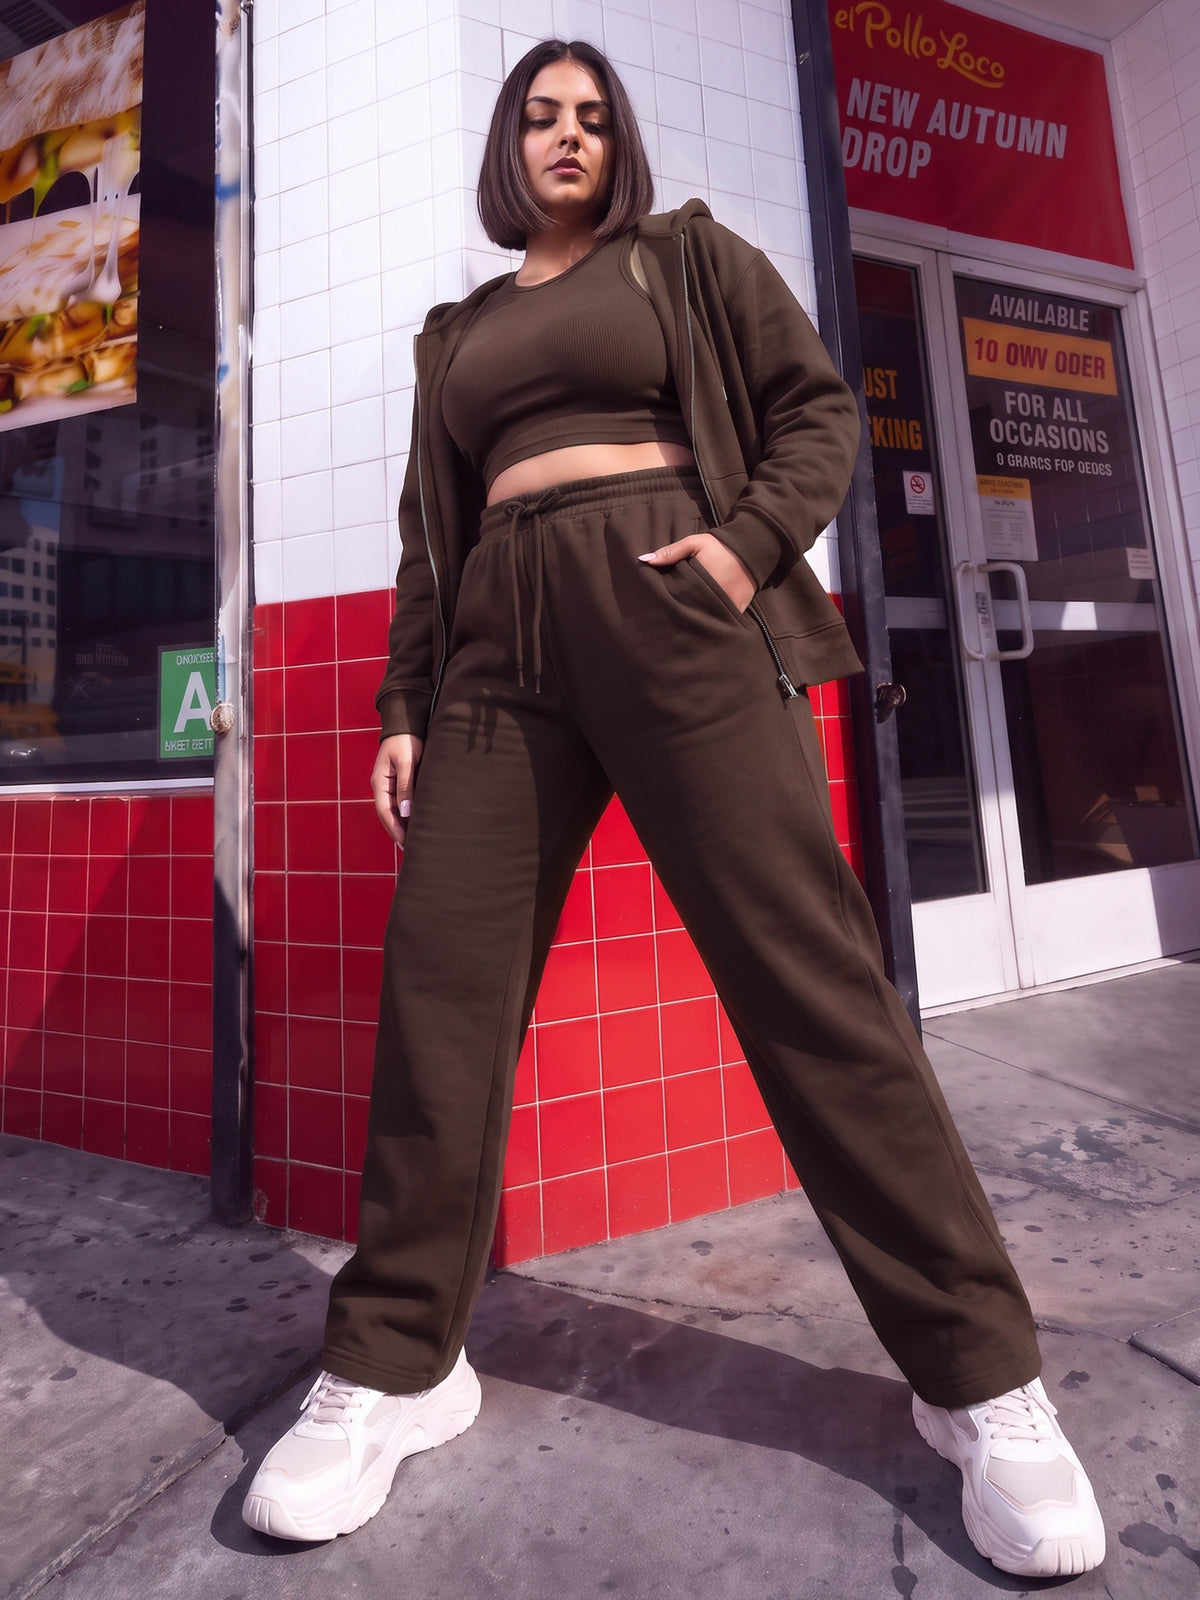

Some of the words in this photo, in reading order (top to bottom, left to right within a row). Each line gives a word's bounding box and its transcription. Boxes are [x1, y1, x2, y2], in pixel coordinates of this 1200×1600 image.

[834, 6, 854, 32] el
[855, 1, 937, 59] Pollo
[936, 29, 1005, 88] Loco
[846, 77, 920, 129] NEW
[926, 99, 1067, 159] AUTUMN
[841, 126, 931, 178] DROP
[989, 293, 1089, 332] AVAILABLE
[974, 337, 999, 363] 10
[1055, 350, 1105, 380] ODER
[1004, 390, 1046, 418] FOR
[1052, 396, 1089, 423] ALL
[989, 418, 1110, 454] OCCASIONS
[173, 671, 213, 733] A
